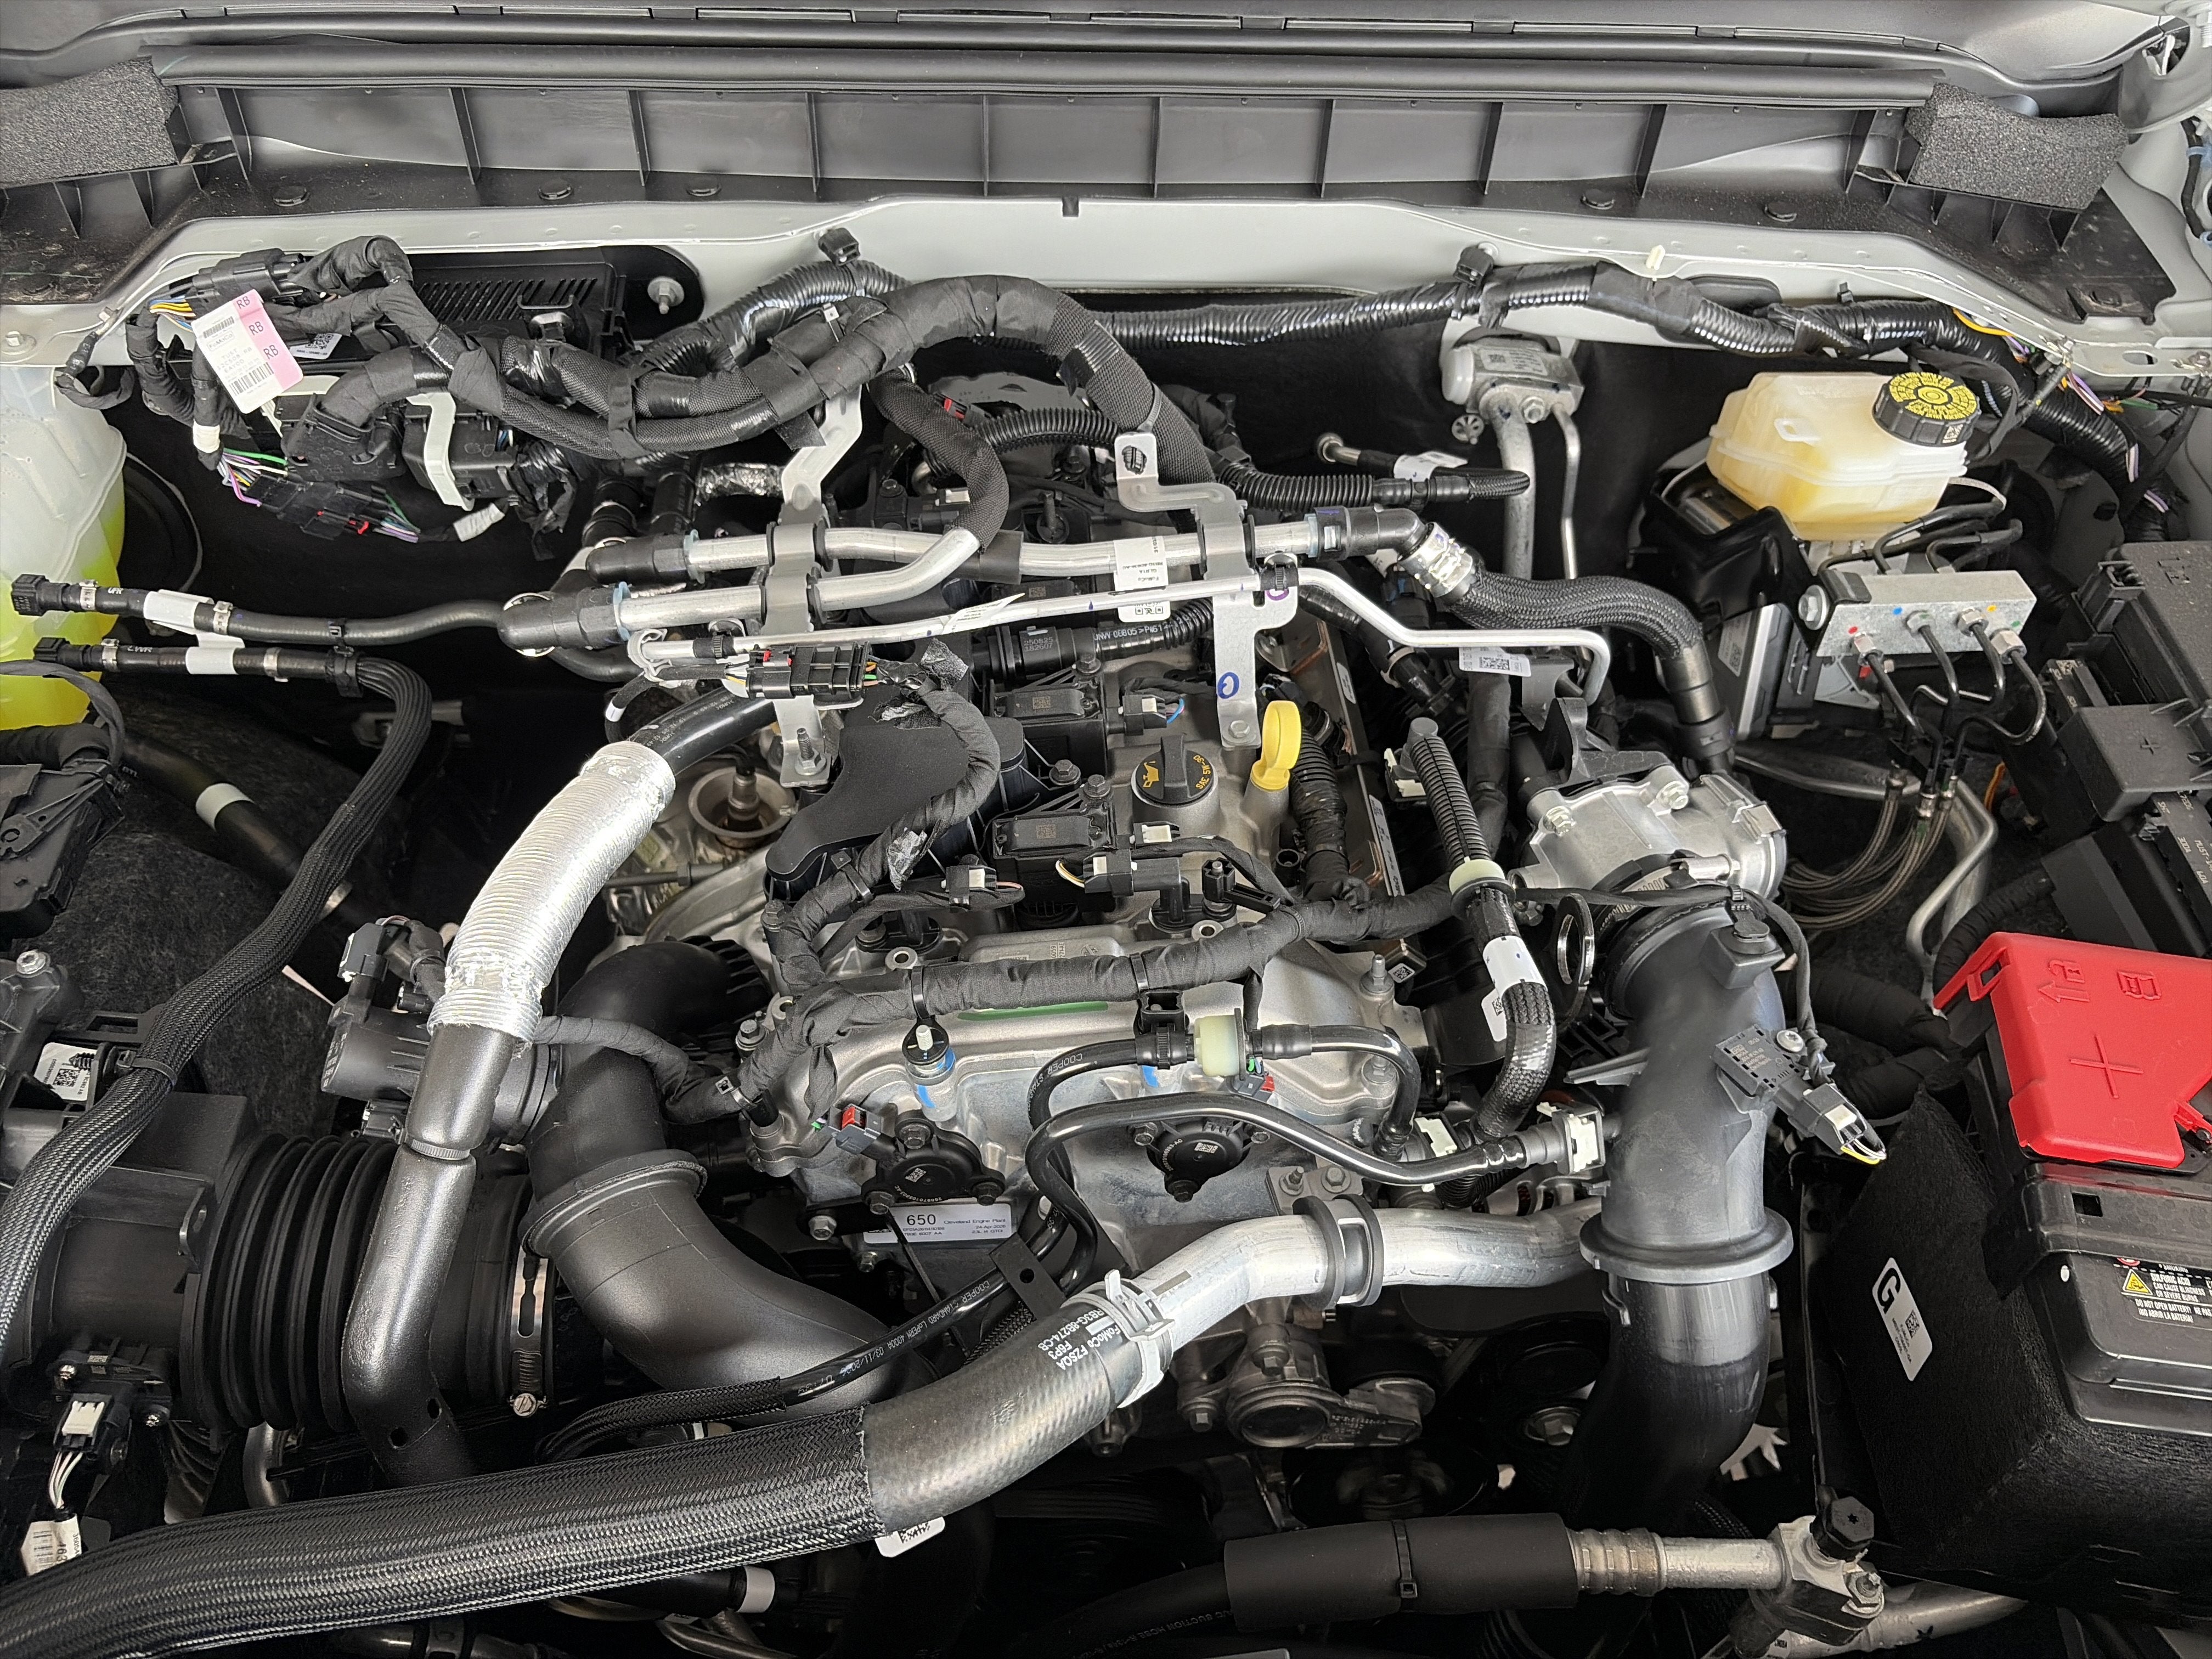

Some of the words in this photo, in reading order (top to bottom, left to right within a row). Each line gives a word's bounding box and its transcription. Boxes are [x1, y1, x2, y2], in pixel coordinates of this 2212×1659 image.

[236, 296, 250, 309] RB
[249, 321, 264, 336] RB
[263, 345, 279, 359] RB
[1193, 754, 1211, 775] 5W-30
[1195, 776, 1210, 790] SAE
[1047, 1053, 1083, 1075] COOPER
[906, 1214, 936, 1226] 650
[2150, 1272, 2177, 1284] SULFURIC
[2177, 1276, 2191, 1286] ACID
[961, 1280, 991, 1304] COOPER
[1877, 1267, 1901, 1314] G
[2153, 1282, 2164, 1290] CAN
[2163, 1283, 2180, 1293] CAUSE
[2179, 1285, 2206, 1296] BLINDNESS
[2155, 1289, 2164, 1298] OR
[2163, 1290, 2182, 1300] SEVERE
[2135, 1298, 2144, 1307] DO
[2143, 1299, 2155, 1309] NOT
[2154, 1301, 2169, 1311] OPEN
[2193, 1306, 2203, 1316] NE
[928, 1299, 959, 1325] STANDARD
[2148, 1309, 2165, 1319] ABRIR
[2163, 1311, 2172, 1320] LA
[1037, 1308, 1105, 1351] RB3G-8B274-CB
[1087, 1324, 1121, 1348] FoMoCo
[1048, 1340, 1073, 1360] F6P3
[1166, 1613, 1214, 1630] SUCTION
